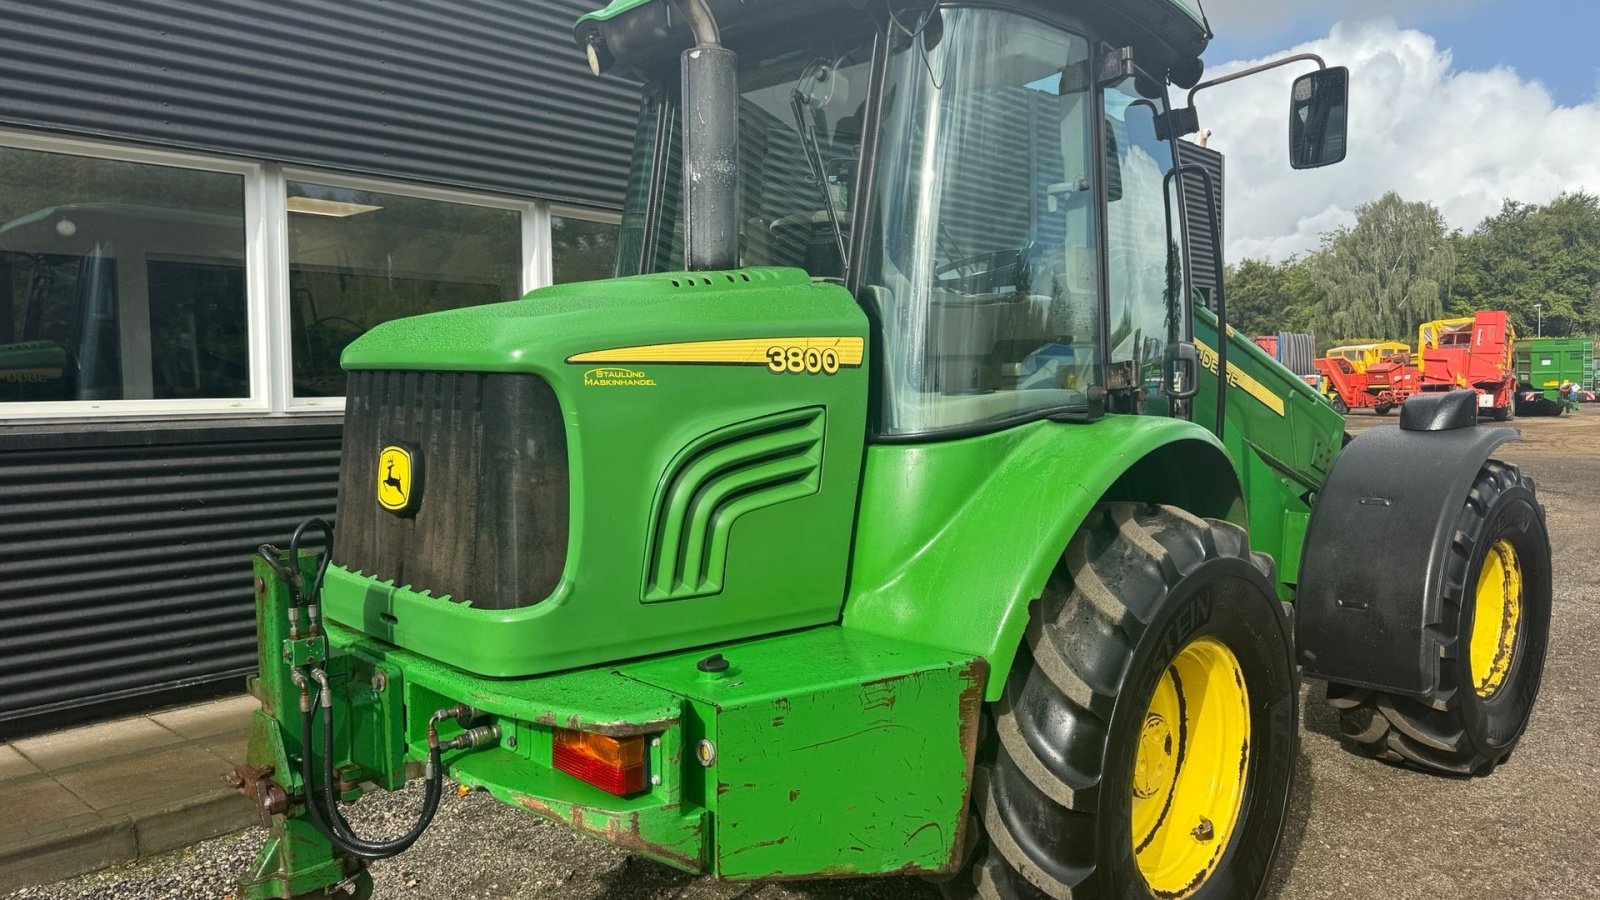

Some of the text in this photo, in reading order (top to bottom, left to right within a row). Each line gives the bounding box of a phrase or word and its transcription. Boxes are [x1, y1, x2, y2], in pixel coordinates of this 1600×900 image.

[596, 369, 645, 378] STAULUND
[766, 346, 839, 376] 3800
[1201, 349, 1238, 388] DERE
